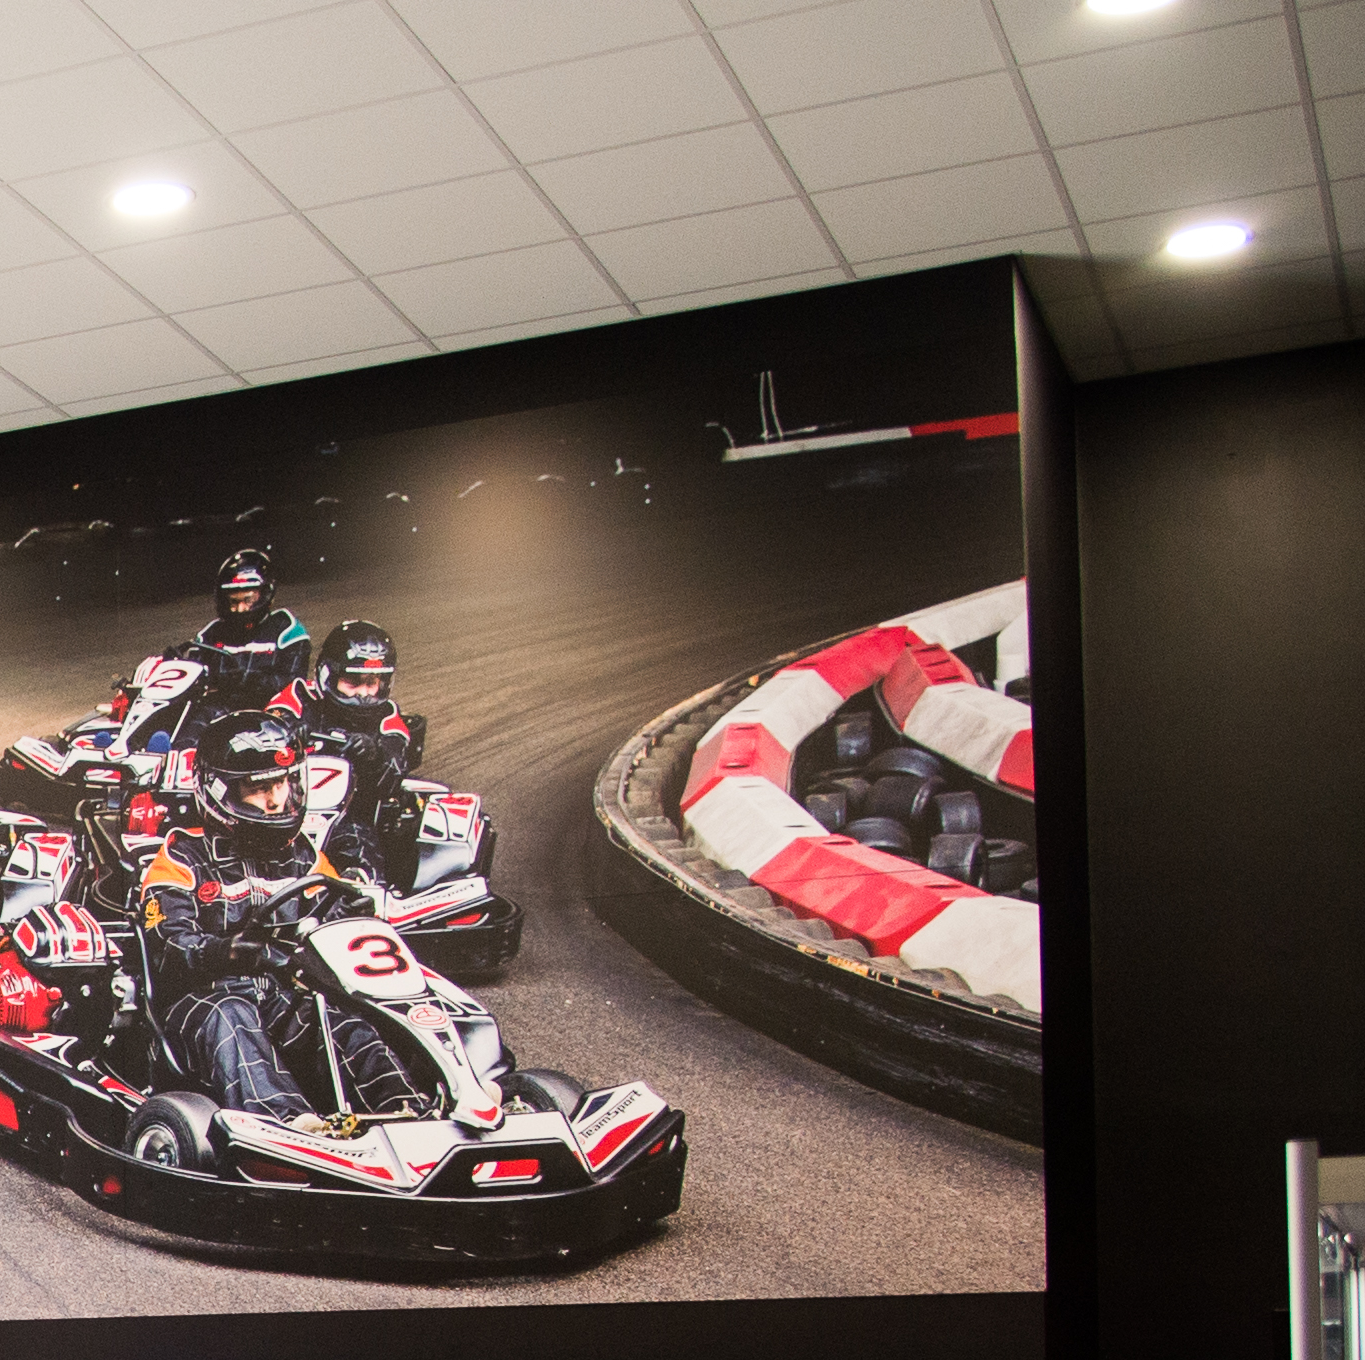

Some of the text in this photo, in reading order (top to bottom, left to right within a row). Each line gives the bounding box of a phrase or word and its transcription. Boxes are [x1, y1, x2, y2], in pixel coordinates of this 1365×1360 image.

[147, 668, 188, 690] 2
[348, 935, 410, 978] 3
[577, 1089, 642, 1139] TeamSport
